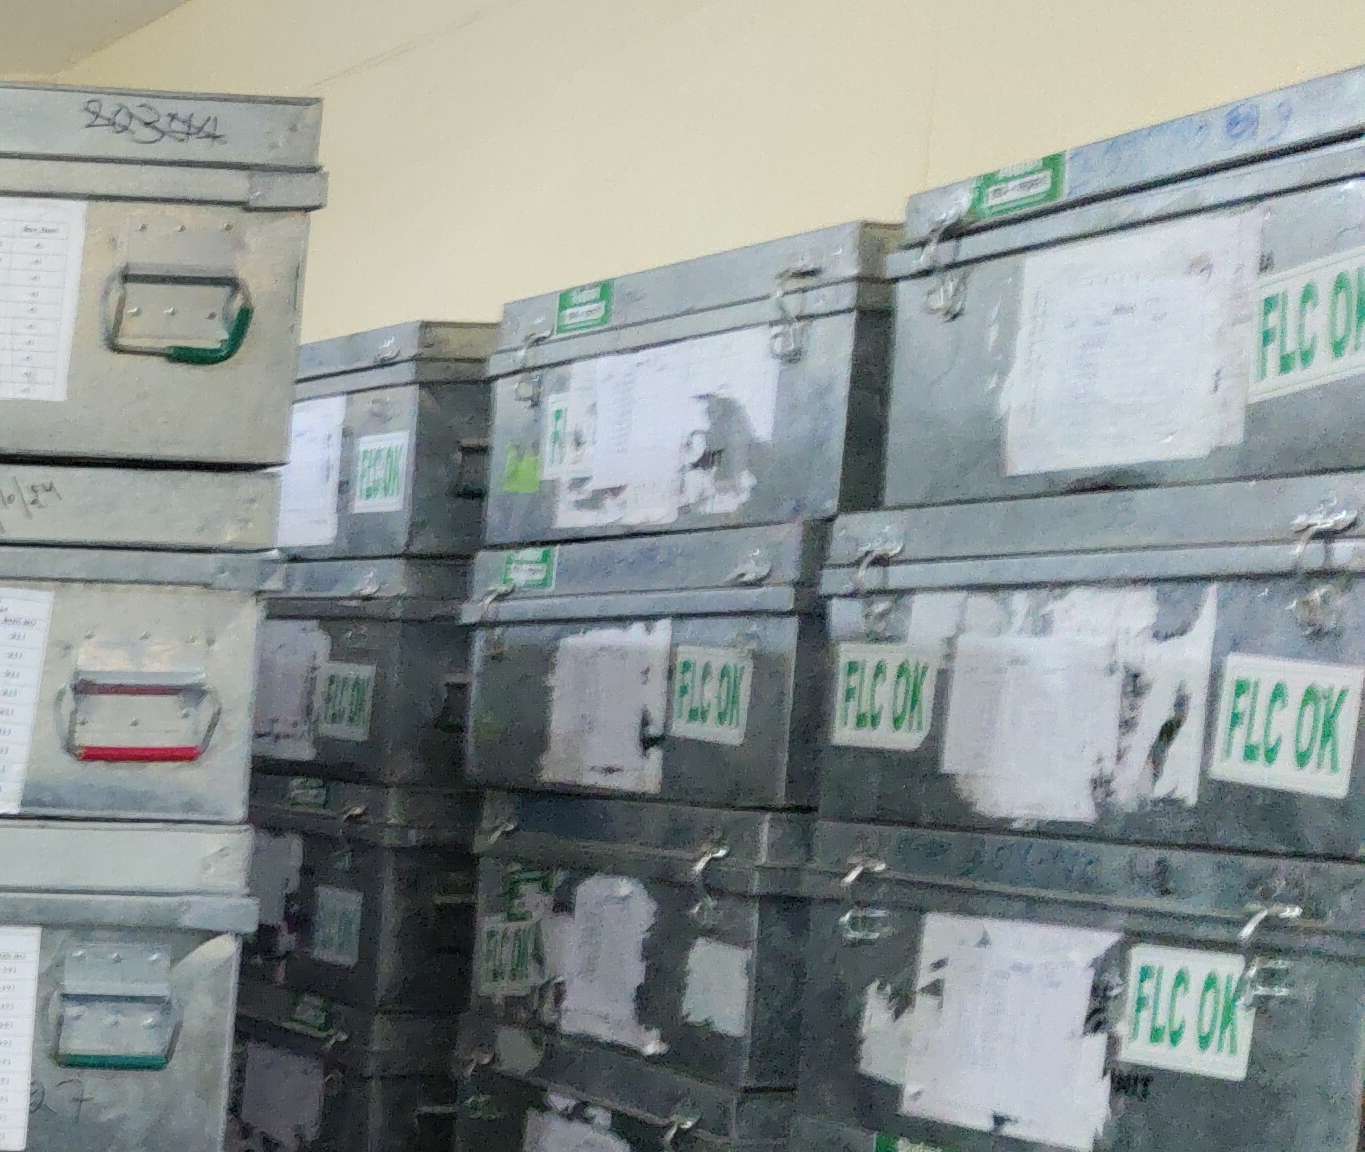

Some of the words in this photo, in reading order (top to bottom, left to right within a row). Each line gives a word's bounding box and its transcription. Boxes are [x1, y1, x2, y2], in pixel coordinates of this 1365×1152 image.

[1257, 281, 1318, 380] FLC
[673, 659, 712, 723] FLC
[843, 659, 887, 731] FLC
[1223, 677, 1287, 765] FLC
[1294, 682, 1349, 774] OK
[1127, 963, 1188, 1047] FLC
[1197, 968, 1246, 1056] OK
